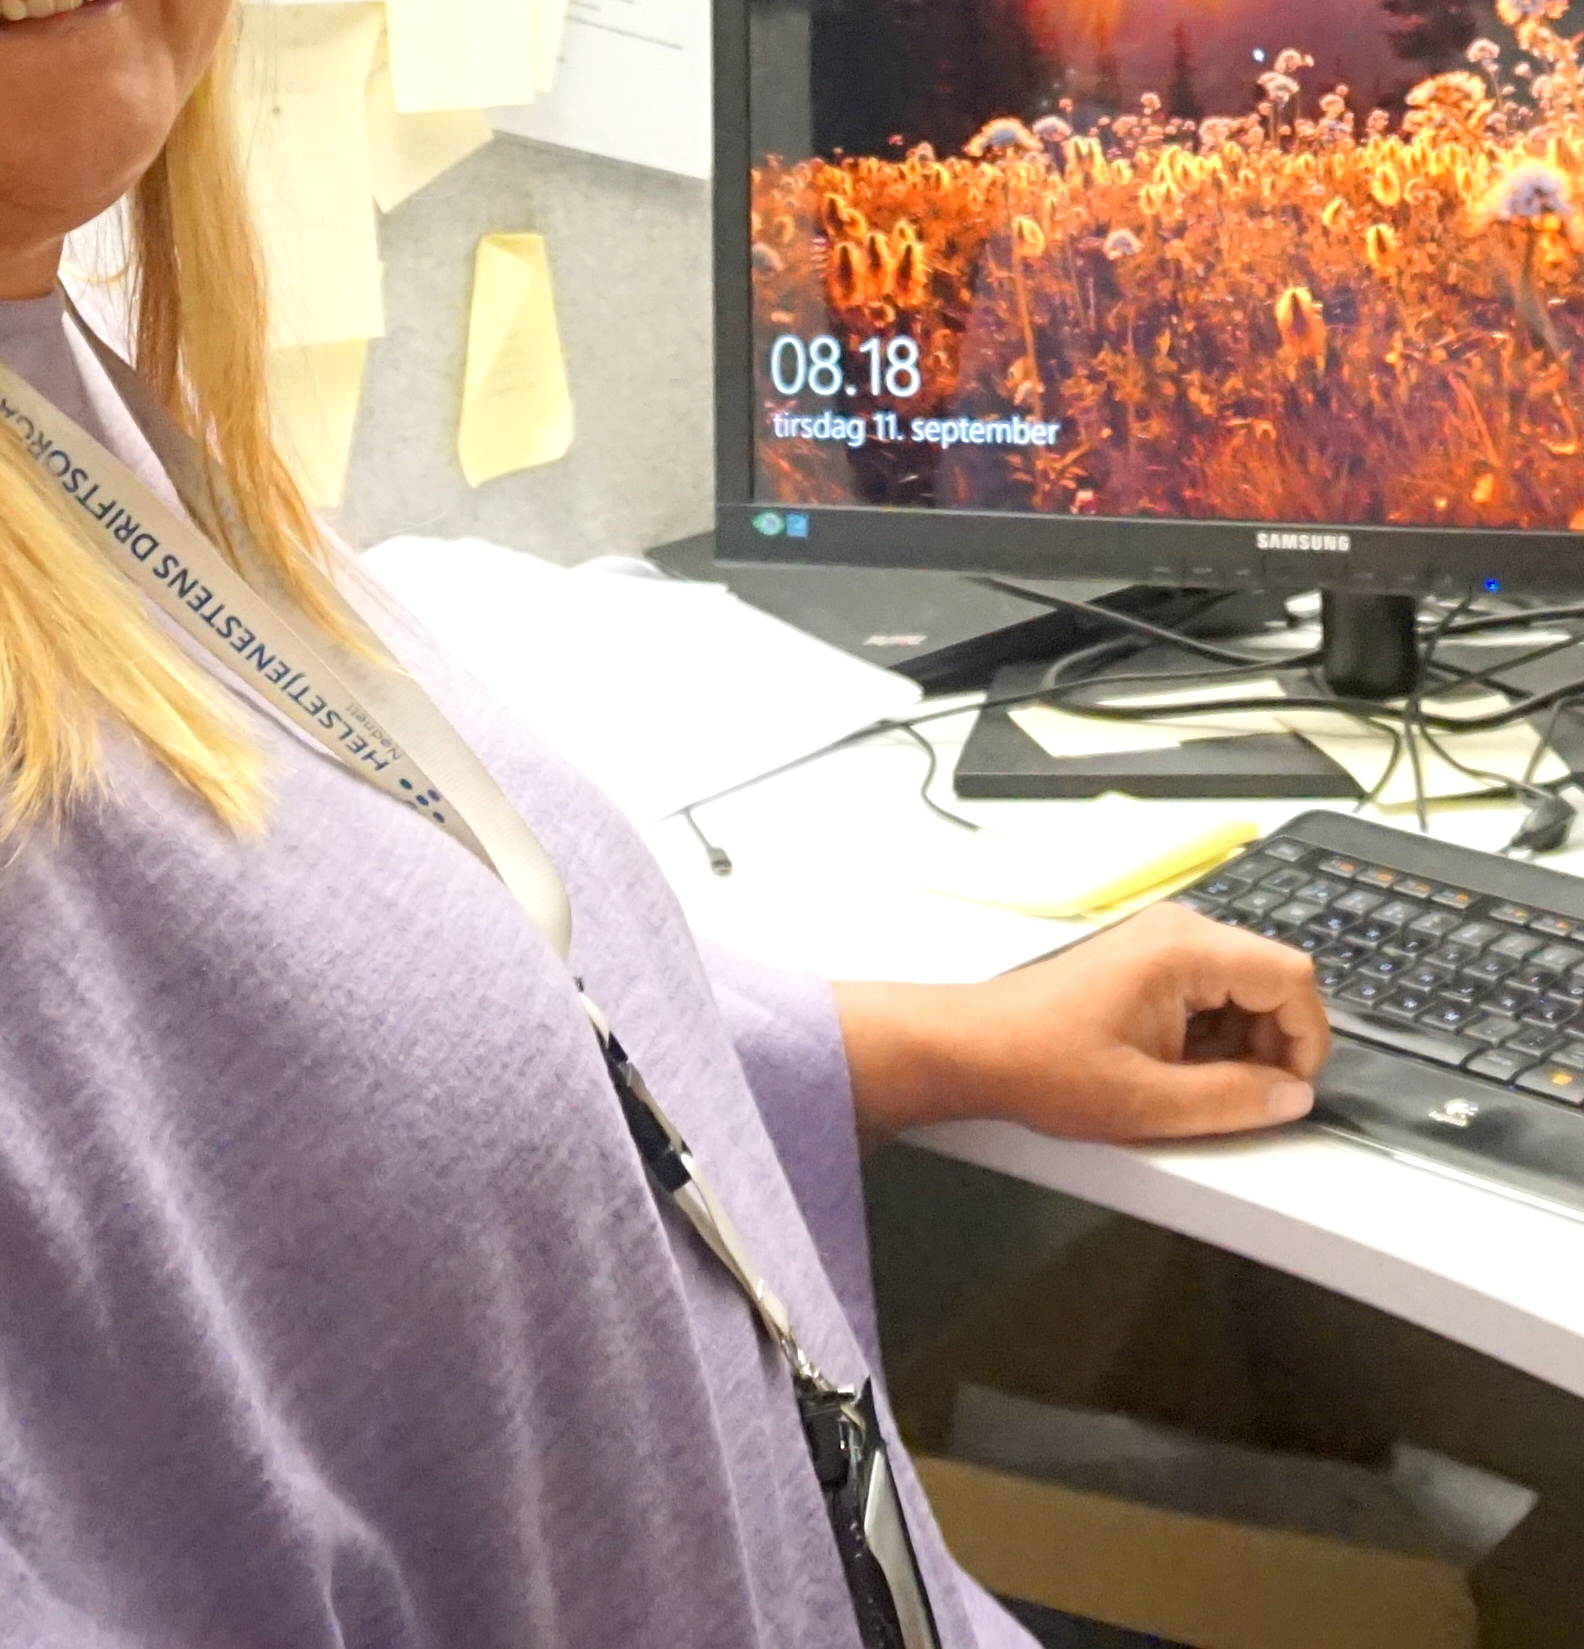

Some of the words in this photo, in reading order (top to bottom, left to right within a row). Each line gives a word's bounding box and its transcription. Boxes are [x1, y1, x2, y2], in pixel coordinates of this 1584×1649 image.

[770, 335, 922, 397] 08.18
[773, 410, 866, 447] tirsdag
[873, 412, 903, 441] 11.
[911, 414, 1062, 449] september
[1256, 532, 1351, 552] SAMSUNG
[152, 553, 390, 772] HELSETJENESTENS
[346, 702, 404, 760] Nødnett
